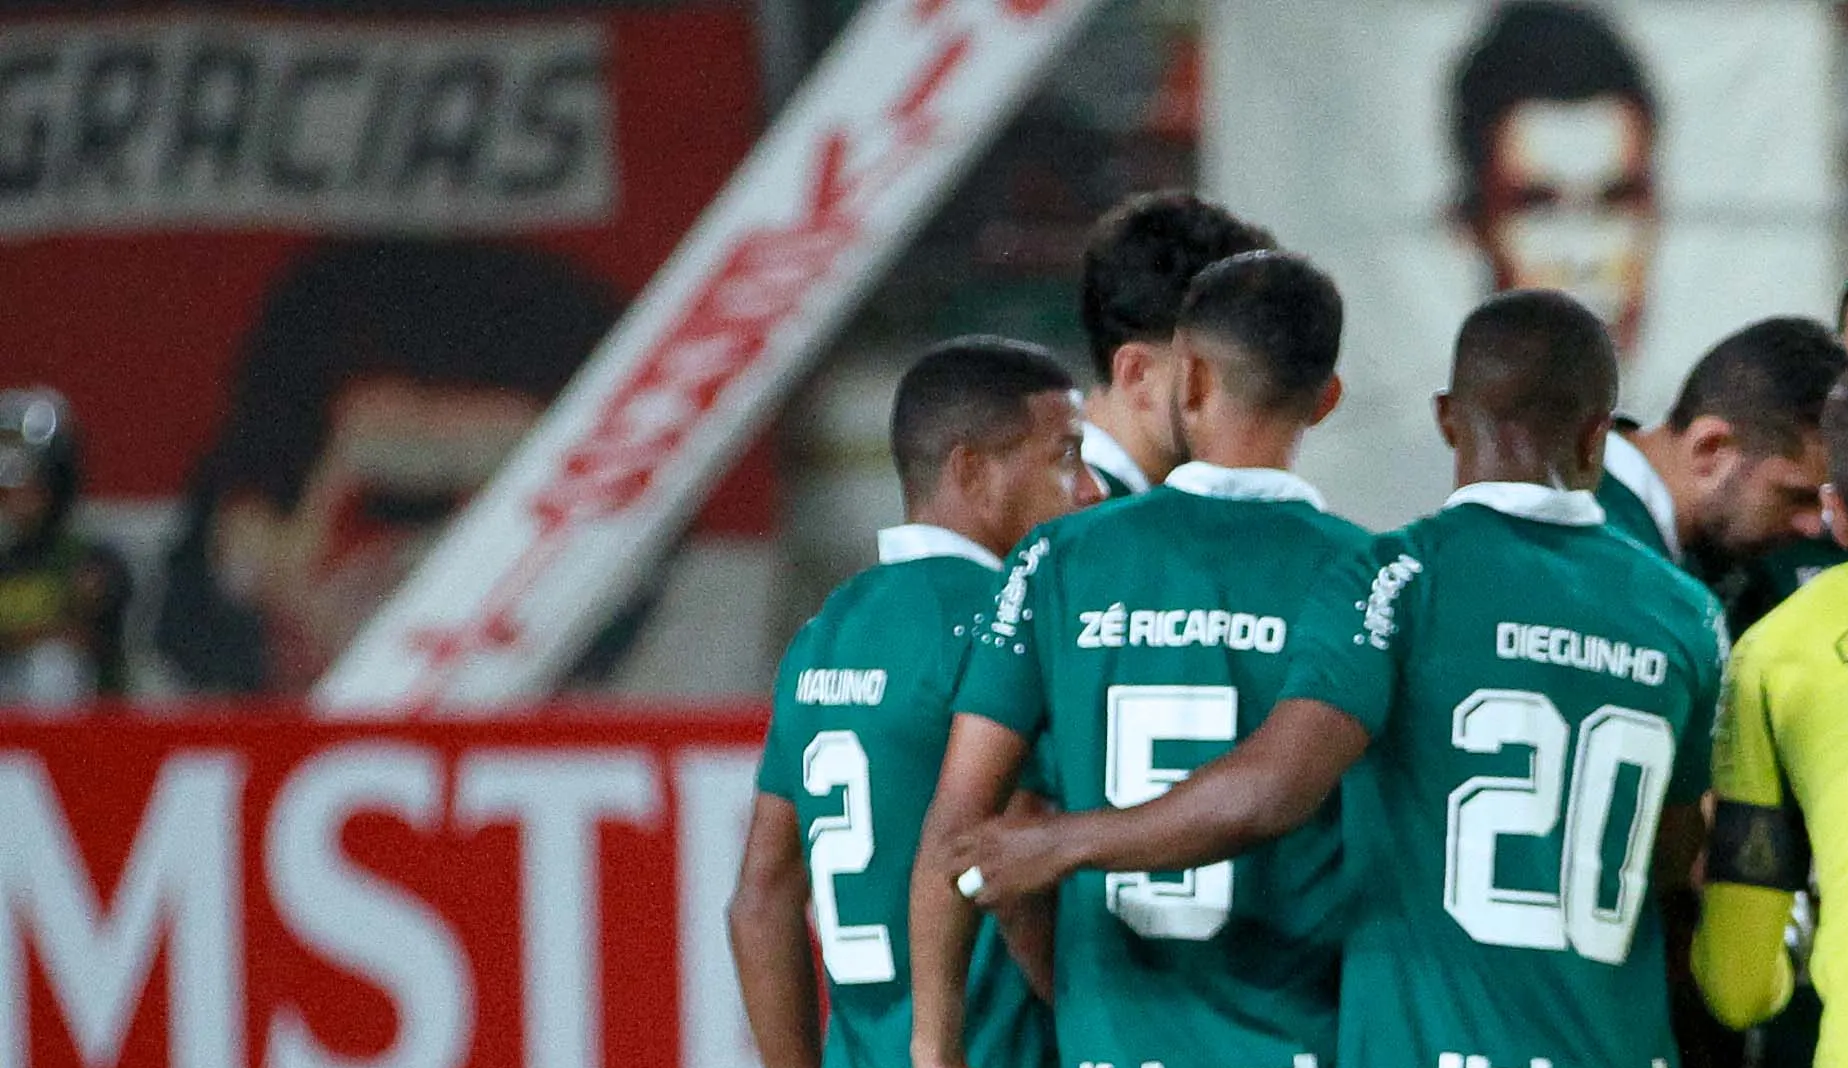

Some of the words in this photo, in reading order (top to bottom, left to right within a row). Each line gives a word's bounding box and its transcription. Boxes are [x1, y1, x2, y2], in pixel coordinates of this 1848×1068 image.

[1076, 602, 1126, 648] ZÉ
[1130, 610, 1286, 653] RICARDO
[1495, 621, 1668, 686] DIEGUINHO
[803, 729, 896, 984] 2
[1104, 684, 1239, 942] 5
[1443, 687, 1677, 964] 20
